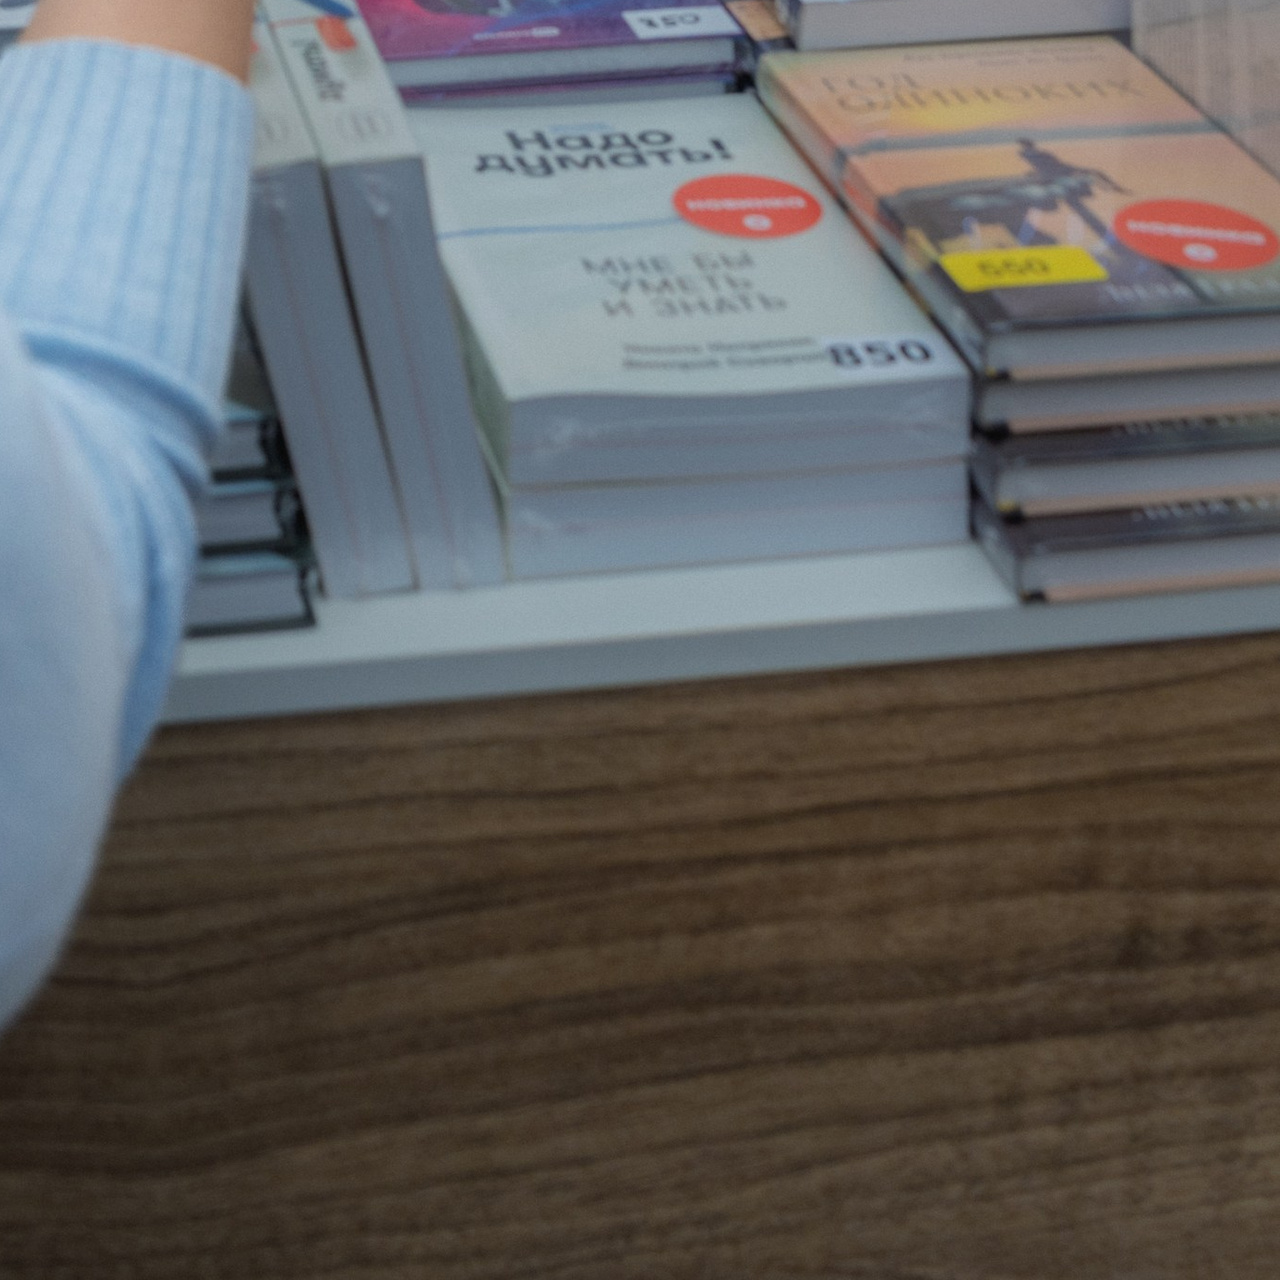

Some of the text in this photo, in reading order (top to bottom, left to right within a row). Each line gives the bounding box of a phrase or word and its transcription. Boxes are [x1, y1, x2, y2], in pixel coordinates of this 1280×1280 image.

[822, 72, 923, 94] ГОД
[839, 78, 1145, 113] ОДИНОКИХ
[504, 130, 676, 152] Надо
[474, 140, 734, 178] думать!
[582, 250, 755, 275] МНЕ БЫ
[978, 258, 1050, 278] 550
[610, 276, 756, 296] УМЕТЬ
[601, 294, 788, 318] И ЗНАТЬ
[828, 340, 935, 368] 850
